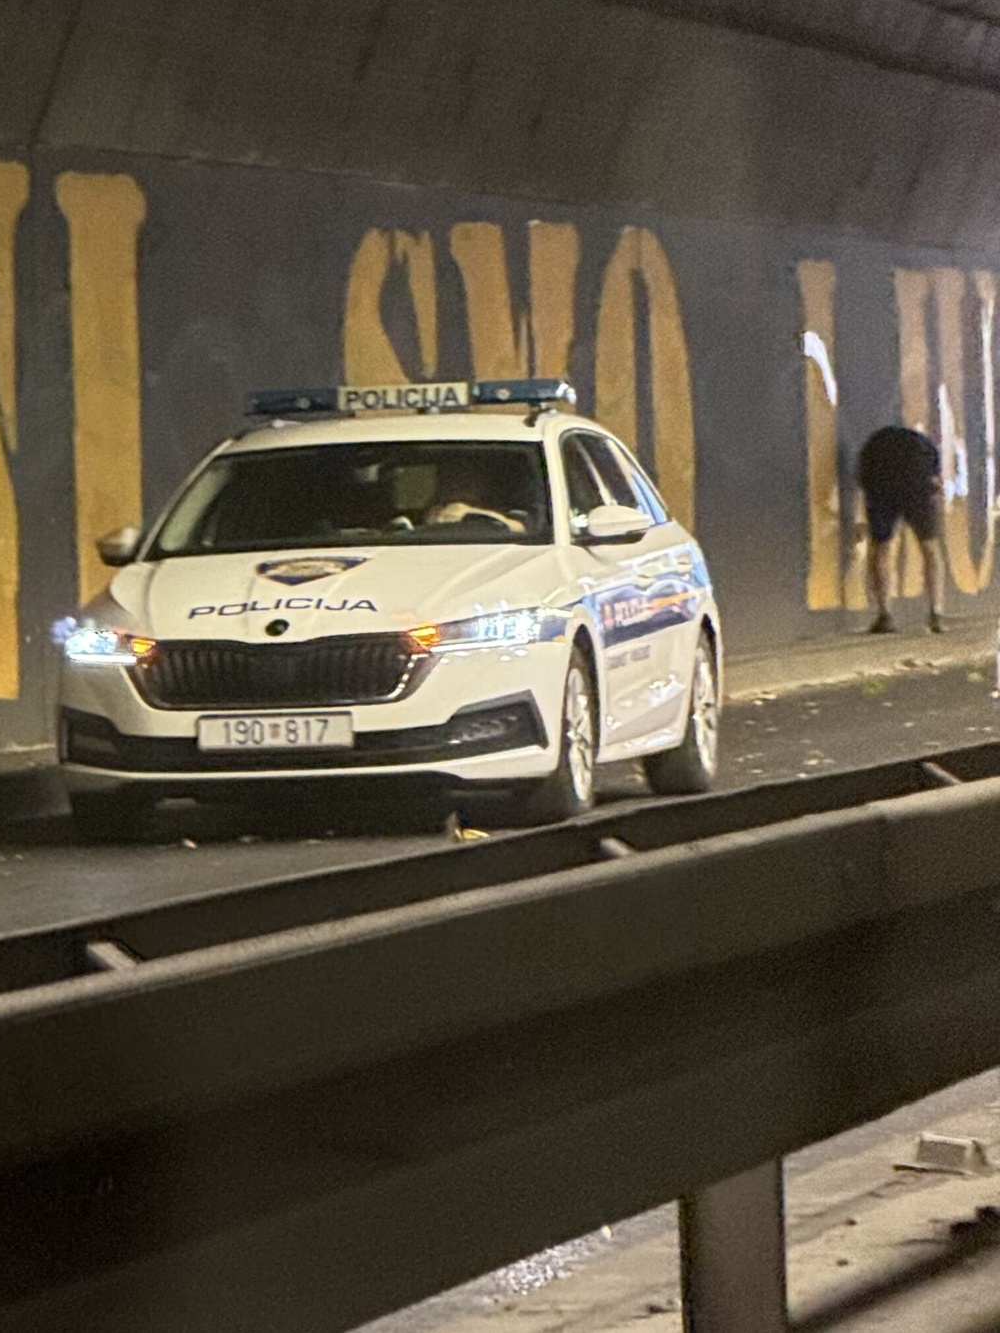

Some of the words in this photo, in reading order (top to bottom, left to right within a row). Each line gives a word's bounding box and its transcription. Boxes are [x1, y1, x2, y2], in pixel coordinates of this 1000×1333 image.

[345, 386, 461, 409] POLICIJA
[187, 598, 378, 619] POLICIJA
[223, 720, 265, 745] 190
[284, 719, 329, 744] 817
